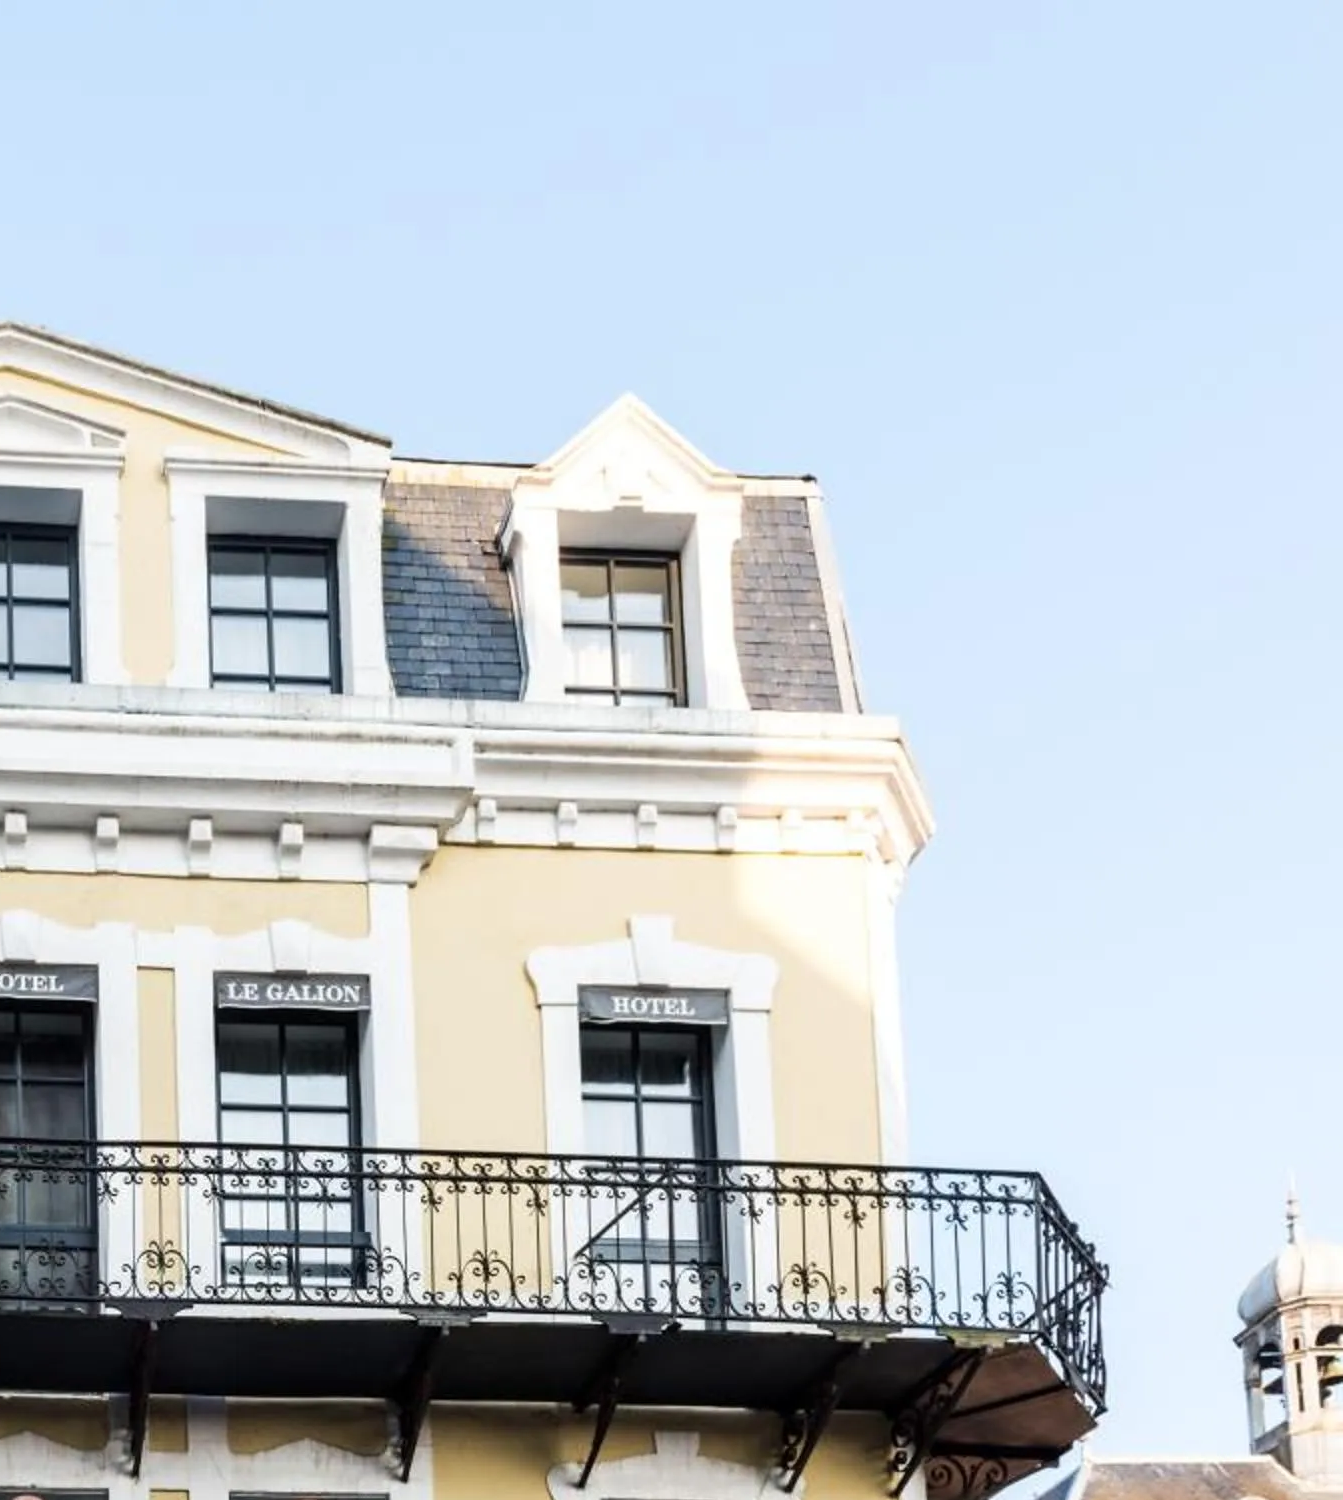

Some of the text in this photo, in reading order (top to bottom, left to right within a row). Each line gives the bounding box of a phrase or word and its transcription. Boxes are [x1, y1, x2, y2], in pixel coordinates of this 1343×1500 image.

[227, 982, 361, 1003] LE GALION
[612, 997, 696, 1016] HOTEL
